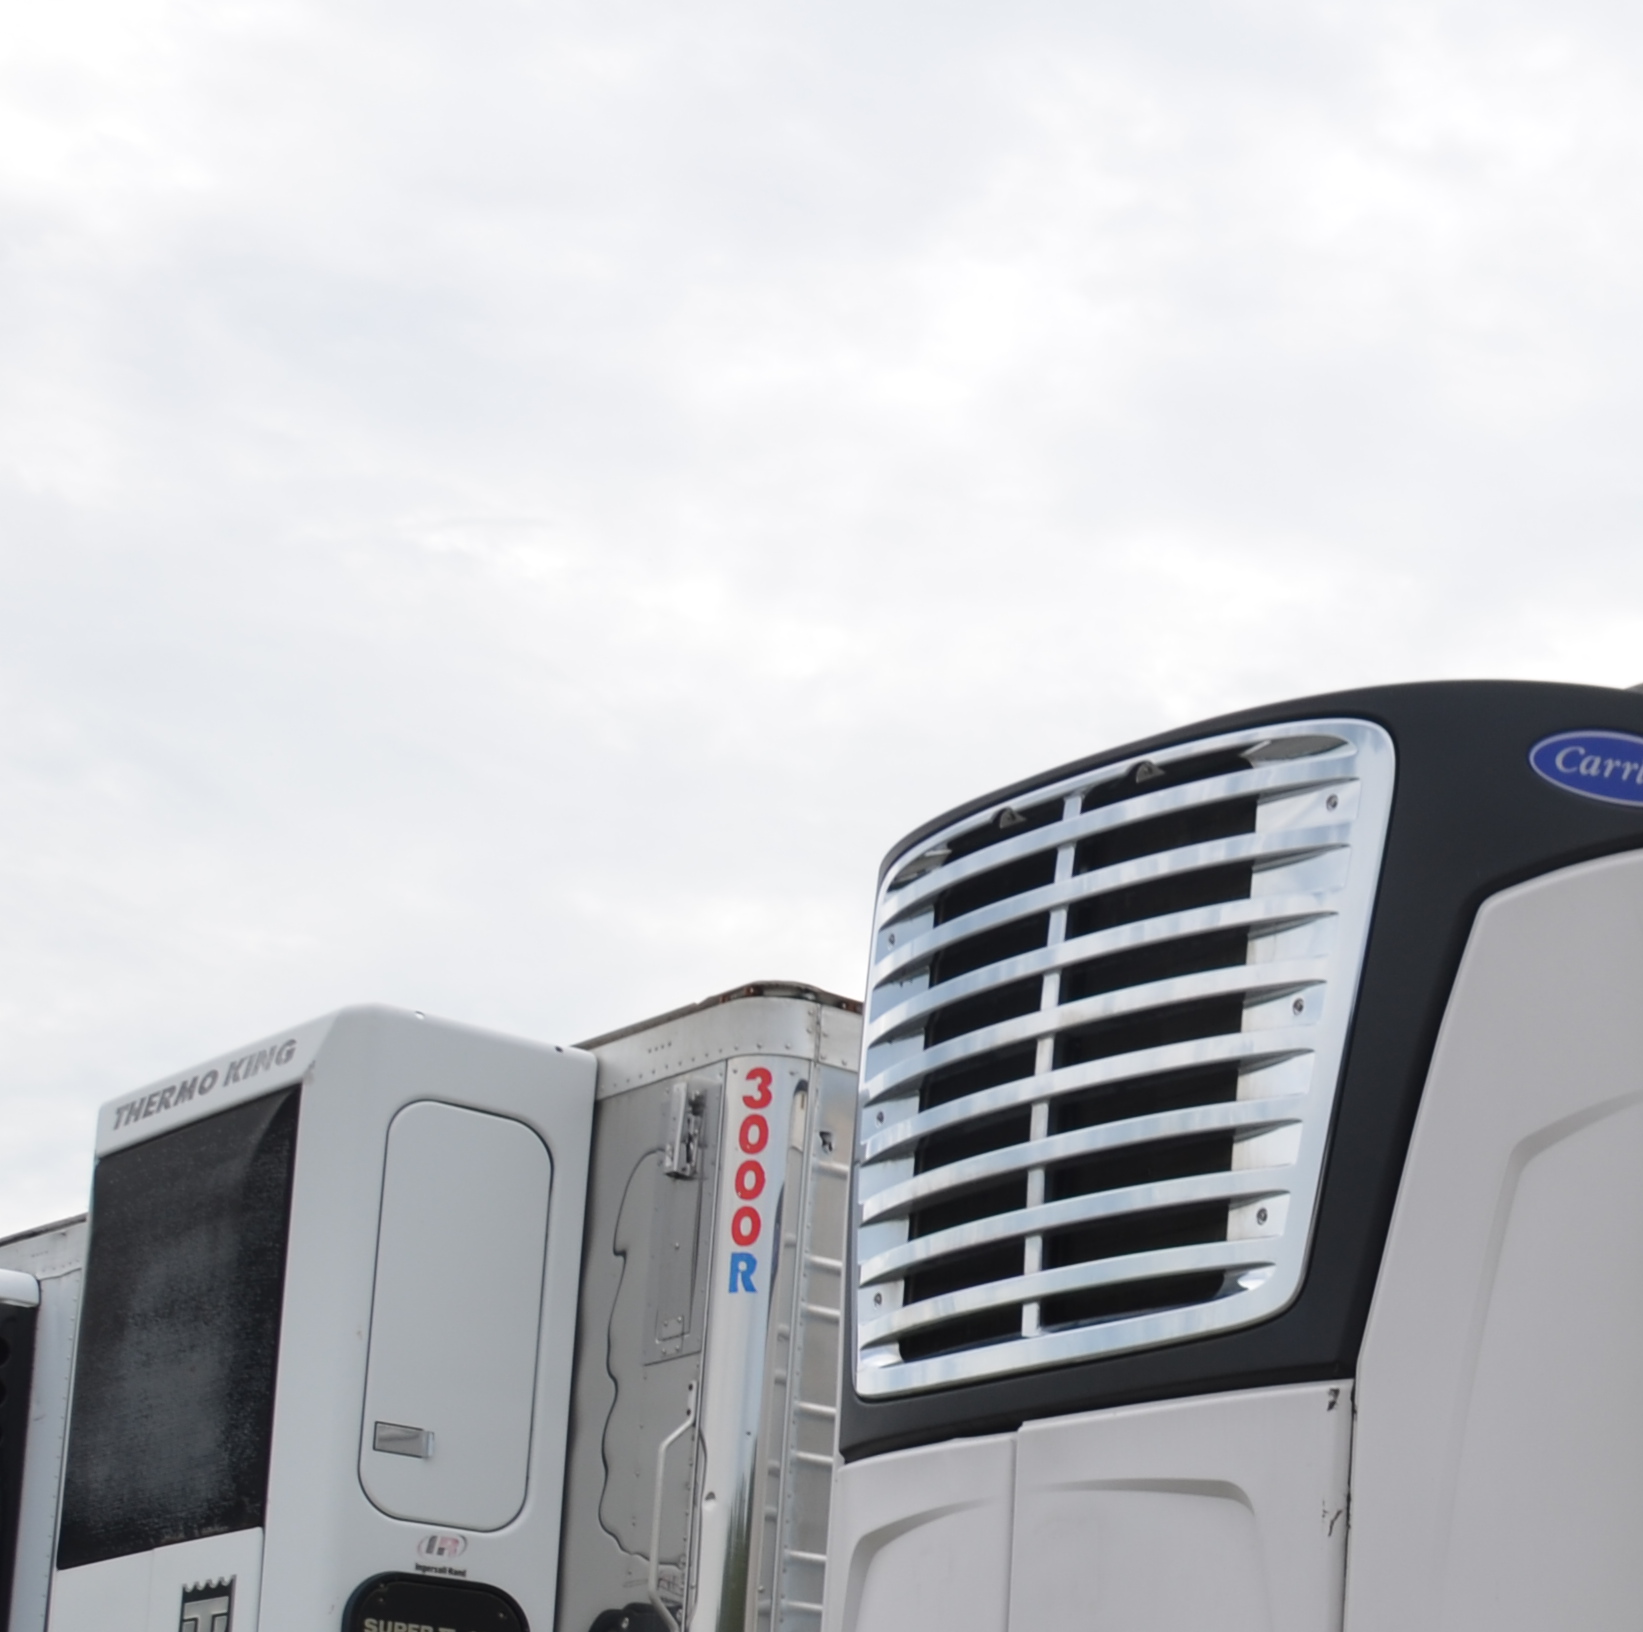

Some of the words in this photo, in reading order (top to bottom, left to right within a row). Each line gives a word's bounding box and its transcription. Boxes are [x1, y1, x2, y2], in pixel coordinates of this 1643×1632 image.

[113, 1069, 218, 1131] THERMO
[222, 1038, 297, 1087] KING
[728, 1067, 772, 1293] 3000R
